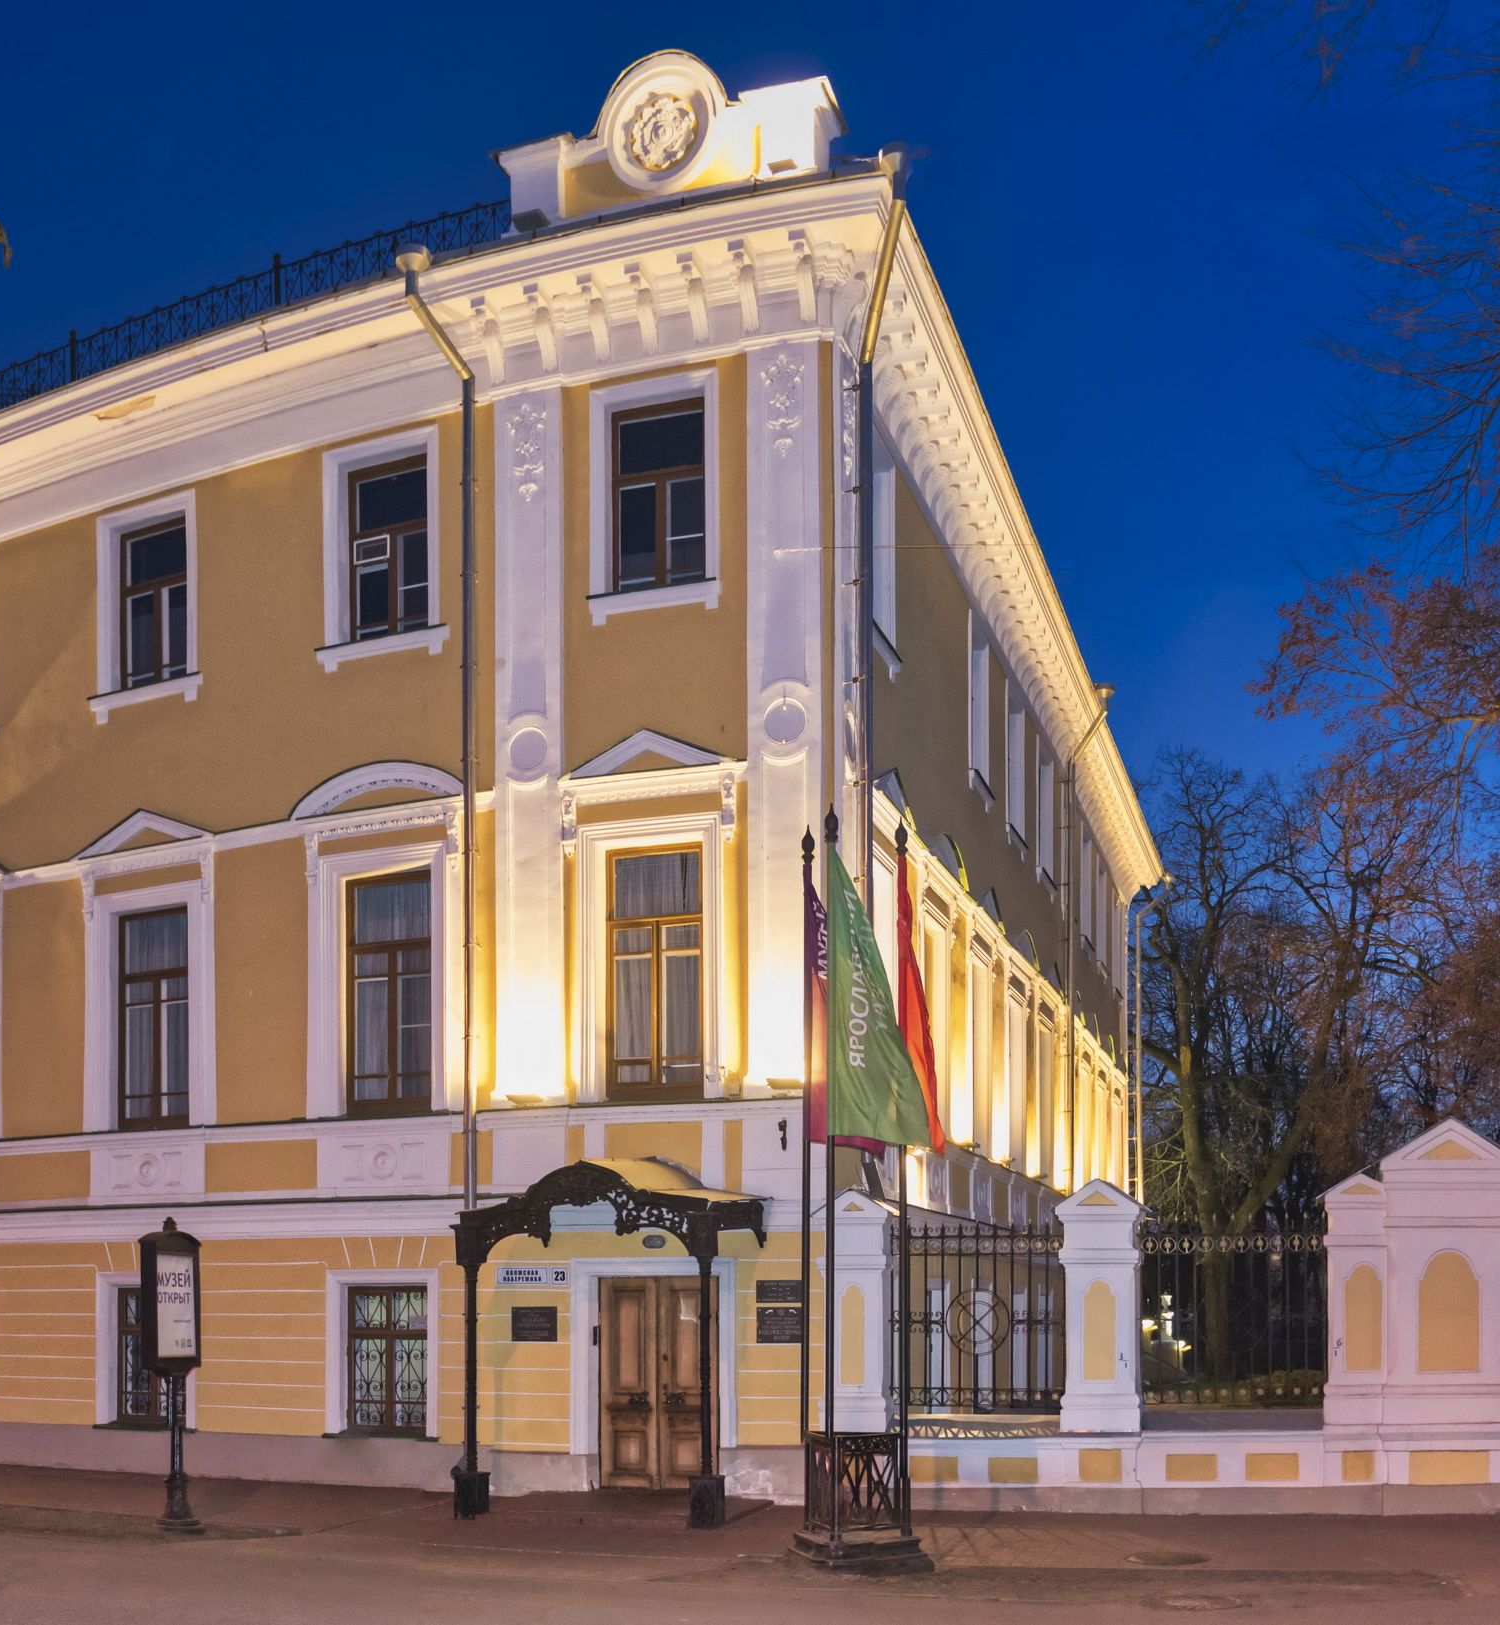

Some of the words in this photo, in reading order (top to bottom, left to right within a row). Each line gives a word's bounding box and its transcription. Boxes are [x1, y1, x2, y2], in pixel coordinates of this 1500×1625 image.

[157, 1268, 191, 1288] МУЗЕЙ
[553, 1271, 566, 1282] 23
[157, 1292, 191, 1304] ОТКРЫТ
